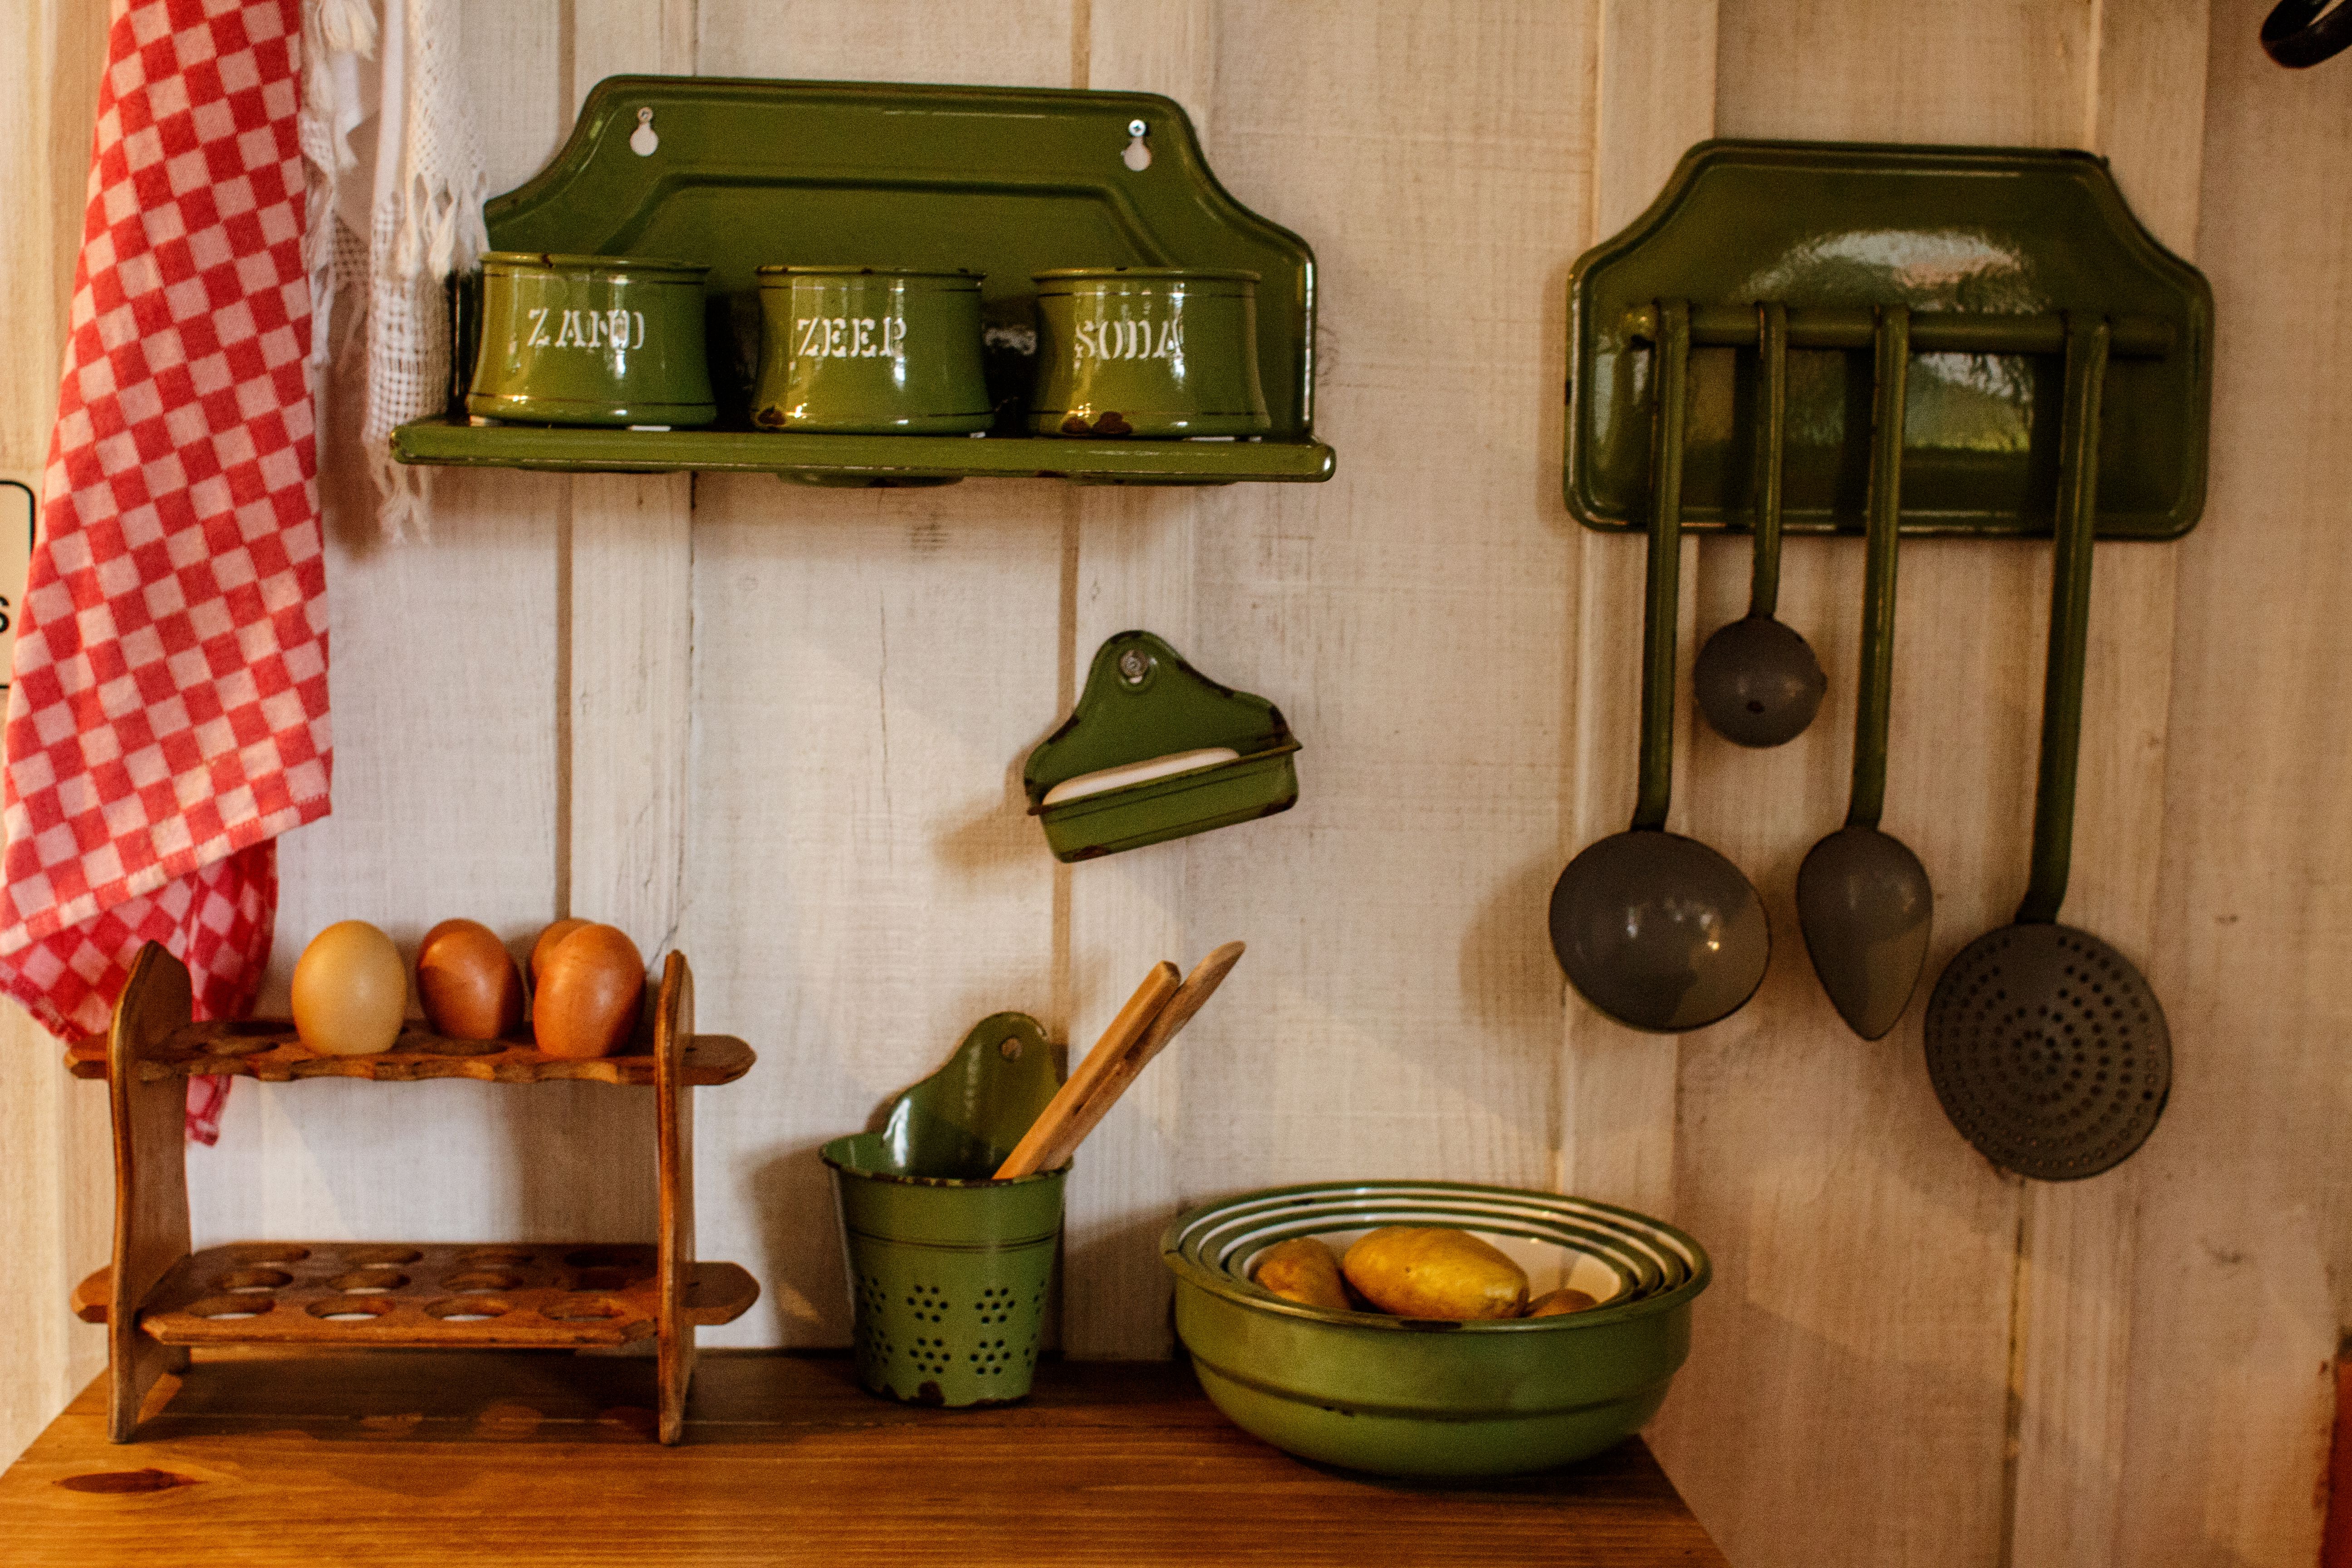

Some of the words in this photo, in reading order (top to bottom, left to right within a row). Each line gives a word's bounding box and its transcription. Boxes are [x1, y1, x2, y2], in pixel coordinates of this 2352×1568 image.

[528, 308, 645, 350] ZAND
[797, 317, 907, 358] ZEEP
[1074, 319, 1184, 360] SODA
